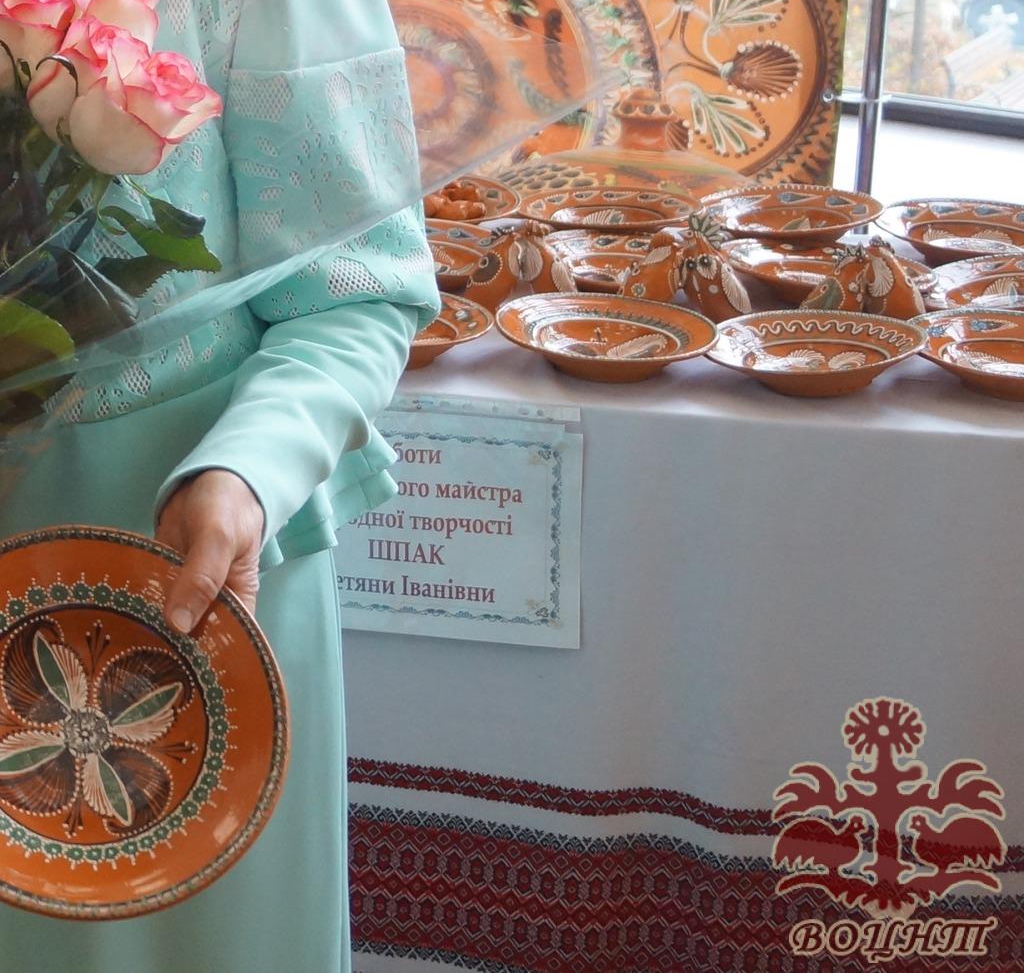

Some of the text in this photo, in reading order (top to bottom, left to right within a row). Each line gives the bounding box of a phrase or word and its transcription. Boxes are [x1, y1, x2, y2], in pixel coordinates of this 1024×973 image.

[393, 442, 442, 464] боти
[397, 480, 522, 507] ого майстра
[348, 510, 513, 538] дної творчості
[368, 539, 445, 565] ШПАК
[337, 575, 496, 603] етяни Іванівни
